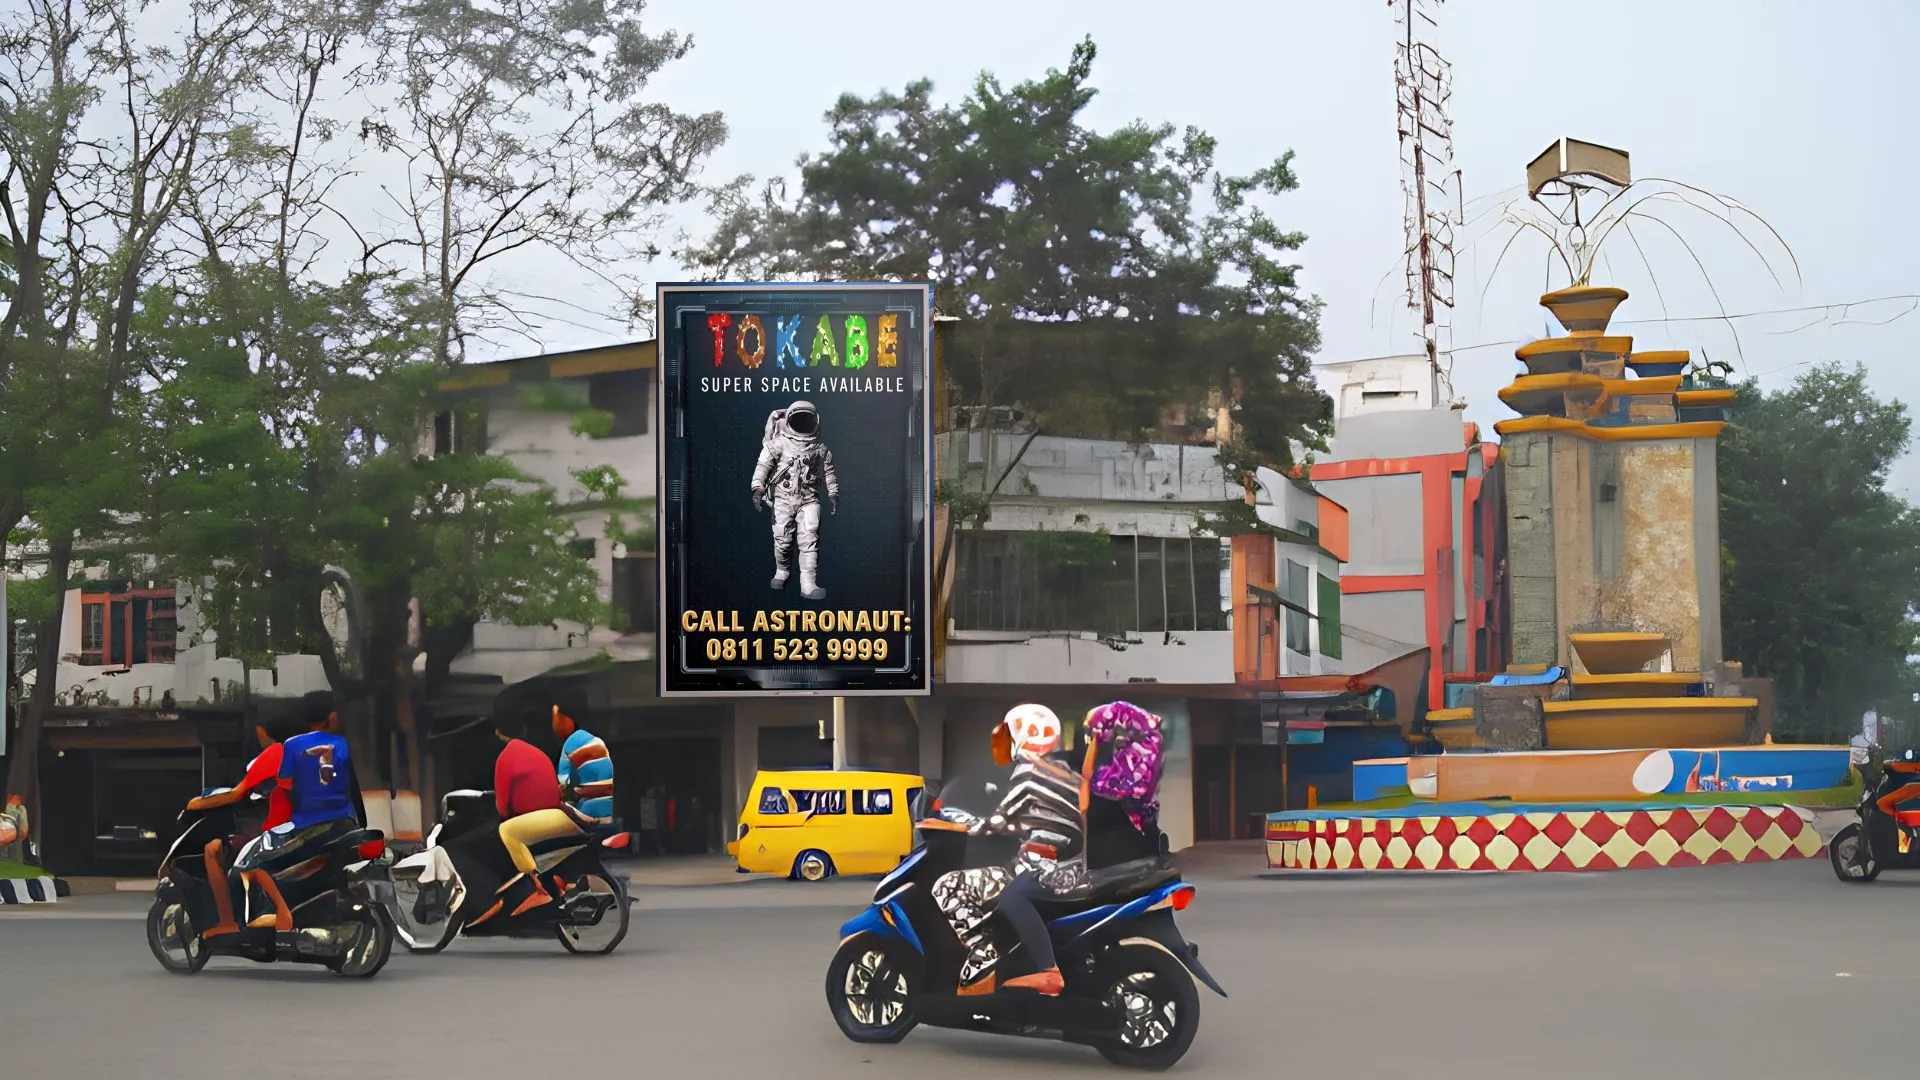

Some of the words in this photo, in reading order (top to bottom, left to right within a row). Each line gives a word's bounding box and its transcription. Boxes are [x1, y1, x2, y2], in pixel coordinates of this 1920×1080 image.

[707, 312, 898, 369] TOKABE
[701, 377, 752, 392] SUPER
[761, 377, 811, 392] SPACE
[820, 377, 904, 392] AVAILABLE
[682, 610, 744, 632] CALL
[752, 610, 912, 632] ASTRONAUT:
[706, 638, 763, 661] 0811
[773, 638, 819, 661] 523
[827, 638, 888, 661] 9999
